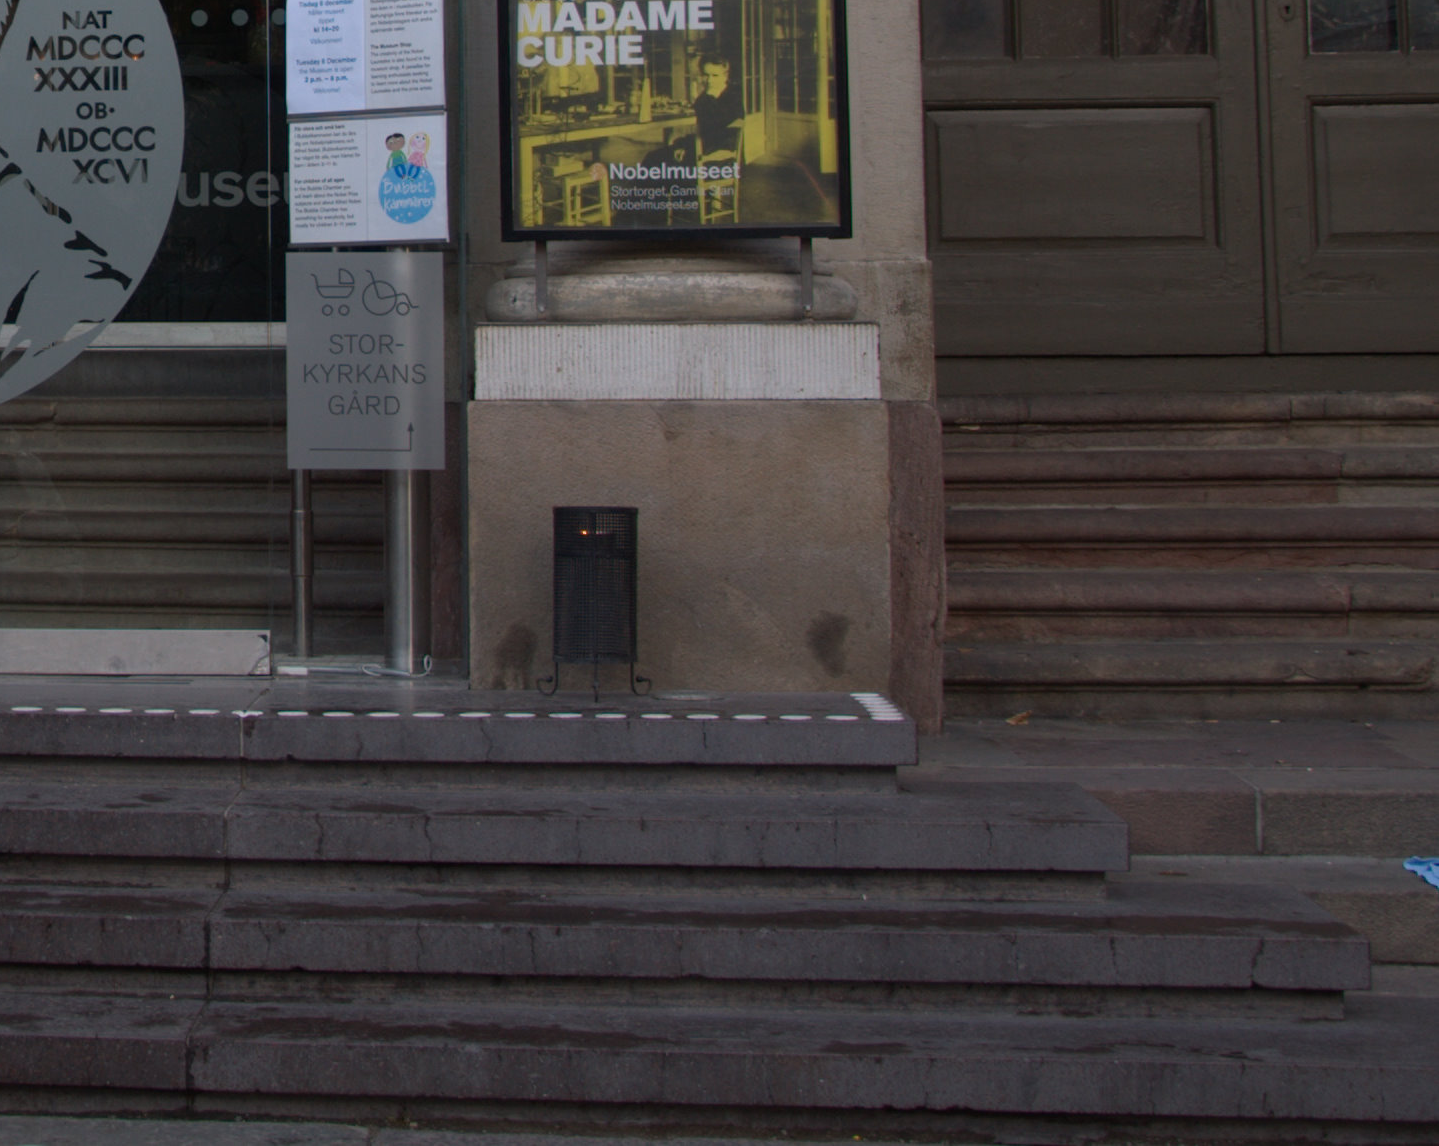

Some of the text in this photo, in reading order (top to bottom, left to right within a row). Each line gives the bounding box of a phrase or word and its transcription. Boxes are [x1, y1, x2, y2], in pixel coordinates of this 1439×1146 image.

[62, 10, 112, 30] NAT
[517, 0, 715, 32] MADAME
[26, 34, 145, 61] MDCCC
[517, 35, 645, 67] CURIE
[34, 66, 128, 92] XXXIII
[36, 126, 156, 153] MDCCC
[72, 158, 148, 184] XCVI
[609, 162, 741, 180] Nobelmuseet
[610, 185, 668, 199] Stortorget,
[709, 185, 735, 196] Stan
[329, 334, 404, 355] STOR-
[303, 364, 427, 385] KYRKANS
[328, 389, 400, 416] GÅRD
